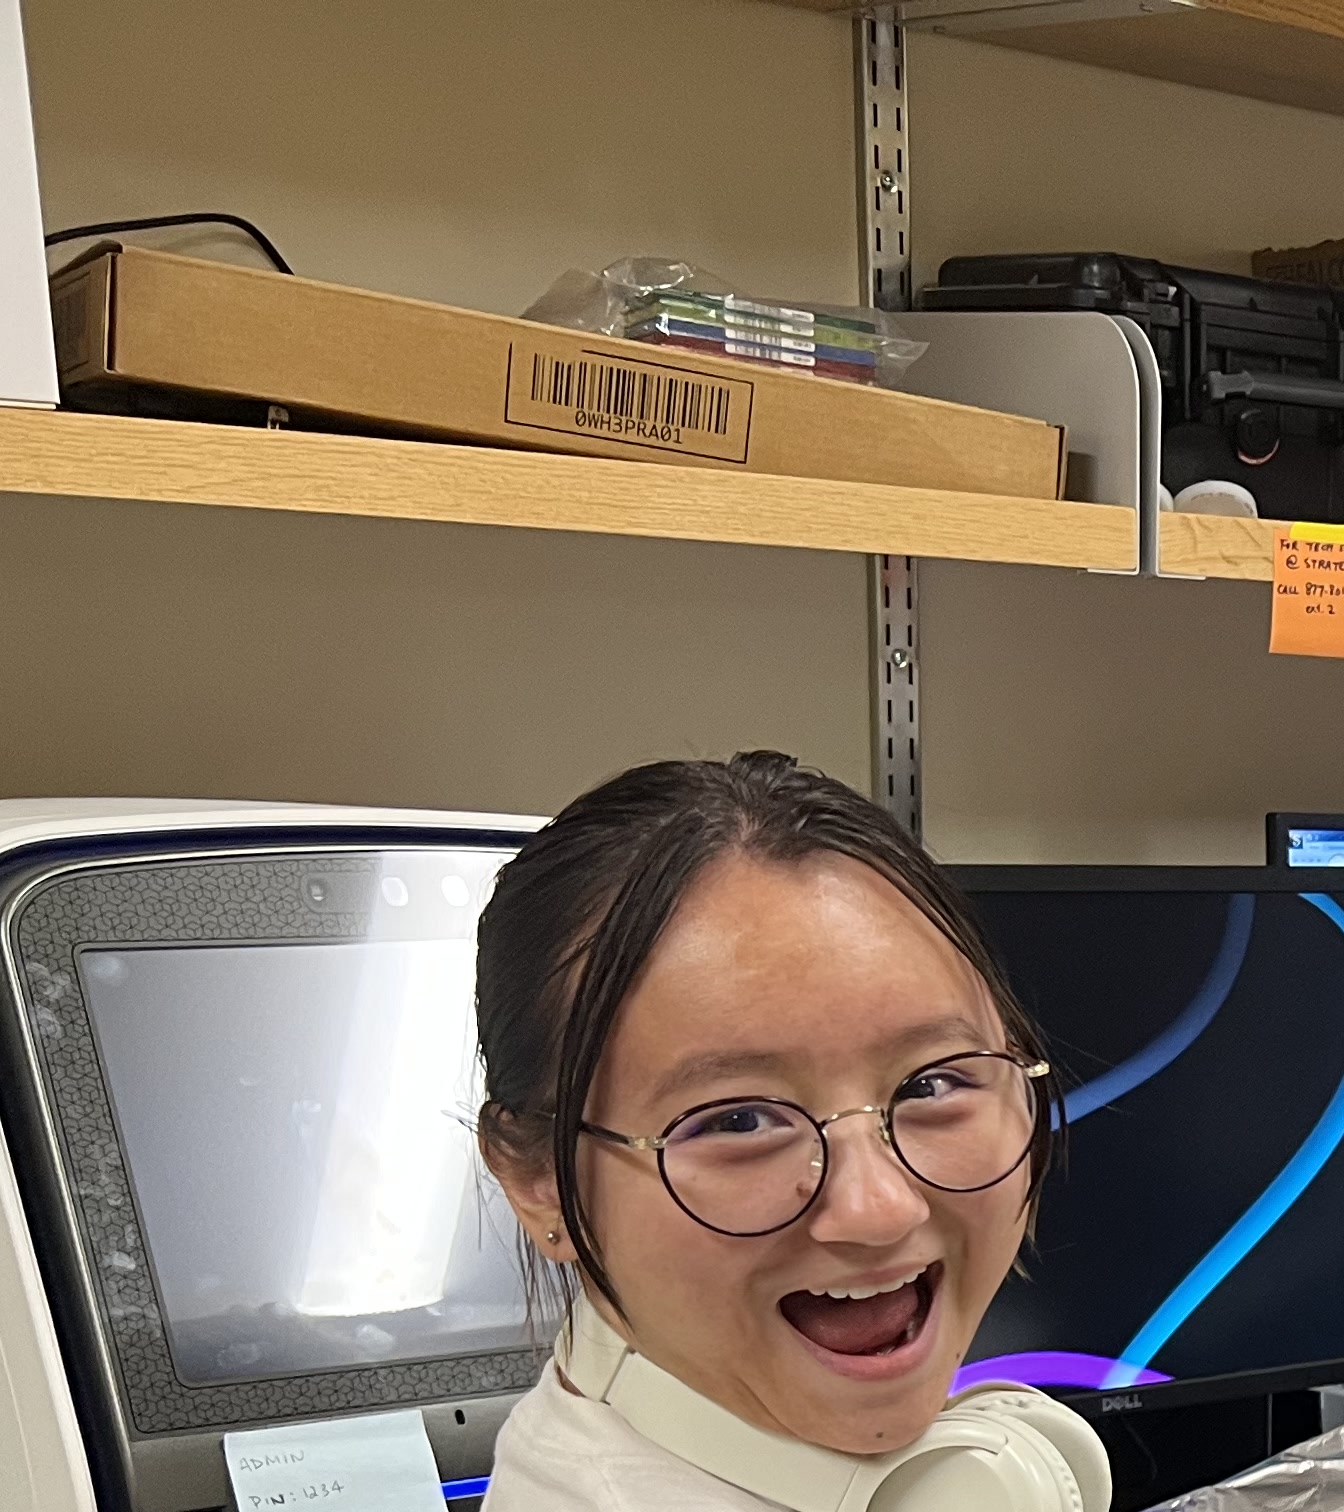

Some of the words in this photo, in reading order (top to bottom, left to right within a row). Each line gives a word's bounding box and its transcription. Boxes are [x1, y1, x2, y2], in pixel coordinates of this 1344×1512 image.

[575, 409, 683, 445] 0WH3PRA01
[1327, 604, 1336, 615] 2
[1102, 1394, 1143, 1413] DELL
[239, 1449, 305, 1472] ADMIN
[302, 1480, 345, 1500] 1234
